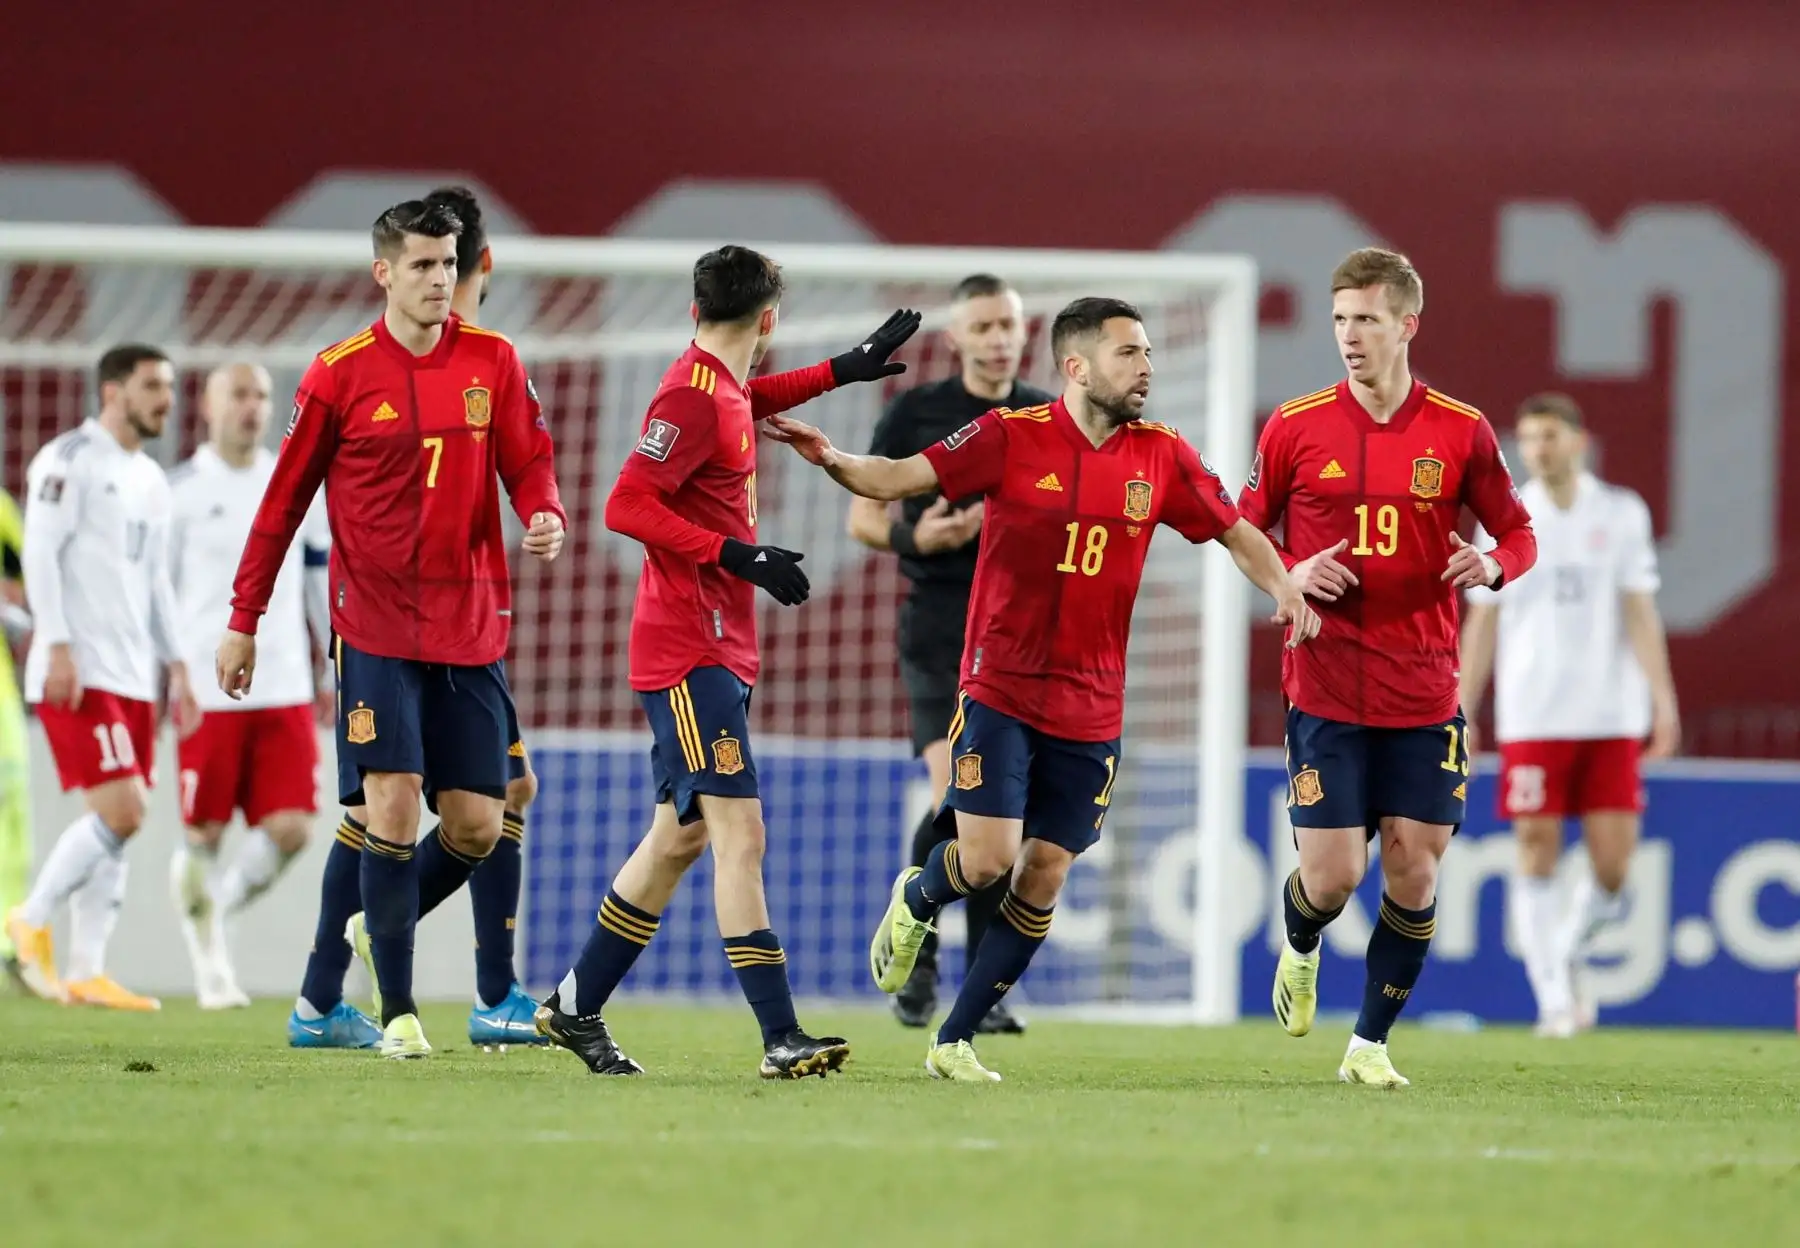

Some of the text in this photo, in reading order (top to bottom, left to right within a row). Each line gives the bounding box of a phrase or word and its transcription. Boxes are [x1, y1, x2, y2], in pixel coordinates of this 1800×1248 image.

[423, 437, 443, 488] 7
[1057, 522, 1108, 576] 18
[1352, 504, 1399, 557] 19
[94, 721, 135, 772] 10
[1094, 755, 1115, 807] 1
